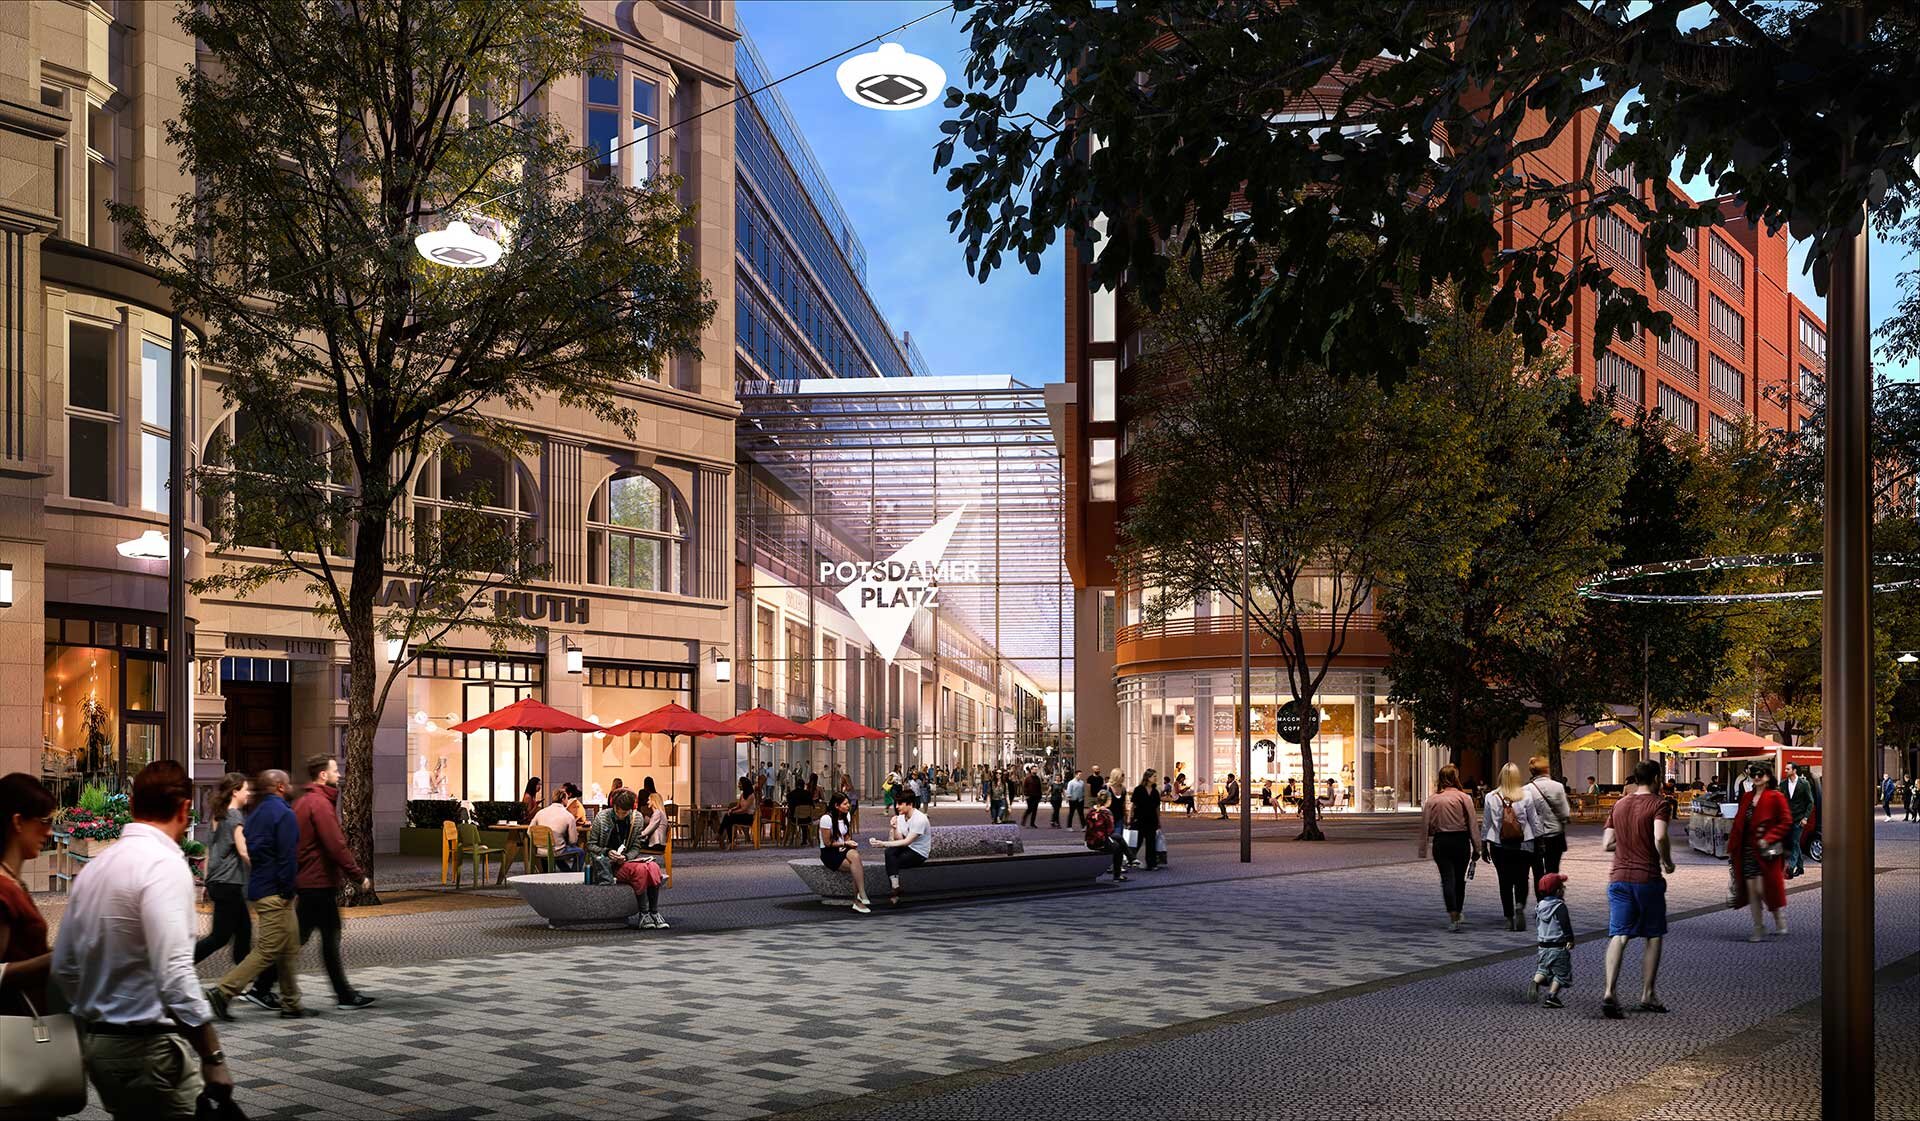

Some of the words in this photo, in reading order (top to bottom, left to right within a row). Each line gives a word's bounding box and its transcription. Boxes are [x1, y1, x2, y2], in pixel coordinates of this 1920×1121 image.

[819, 560, 979, 583] POTSDAMER
[494, 589, 590, 625] HUTH
[860, 586, 940, 609] PLATZ
[224, 634, 268, 651] HAUS
[285, 639, 328, 656] HUTH
